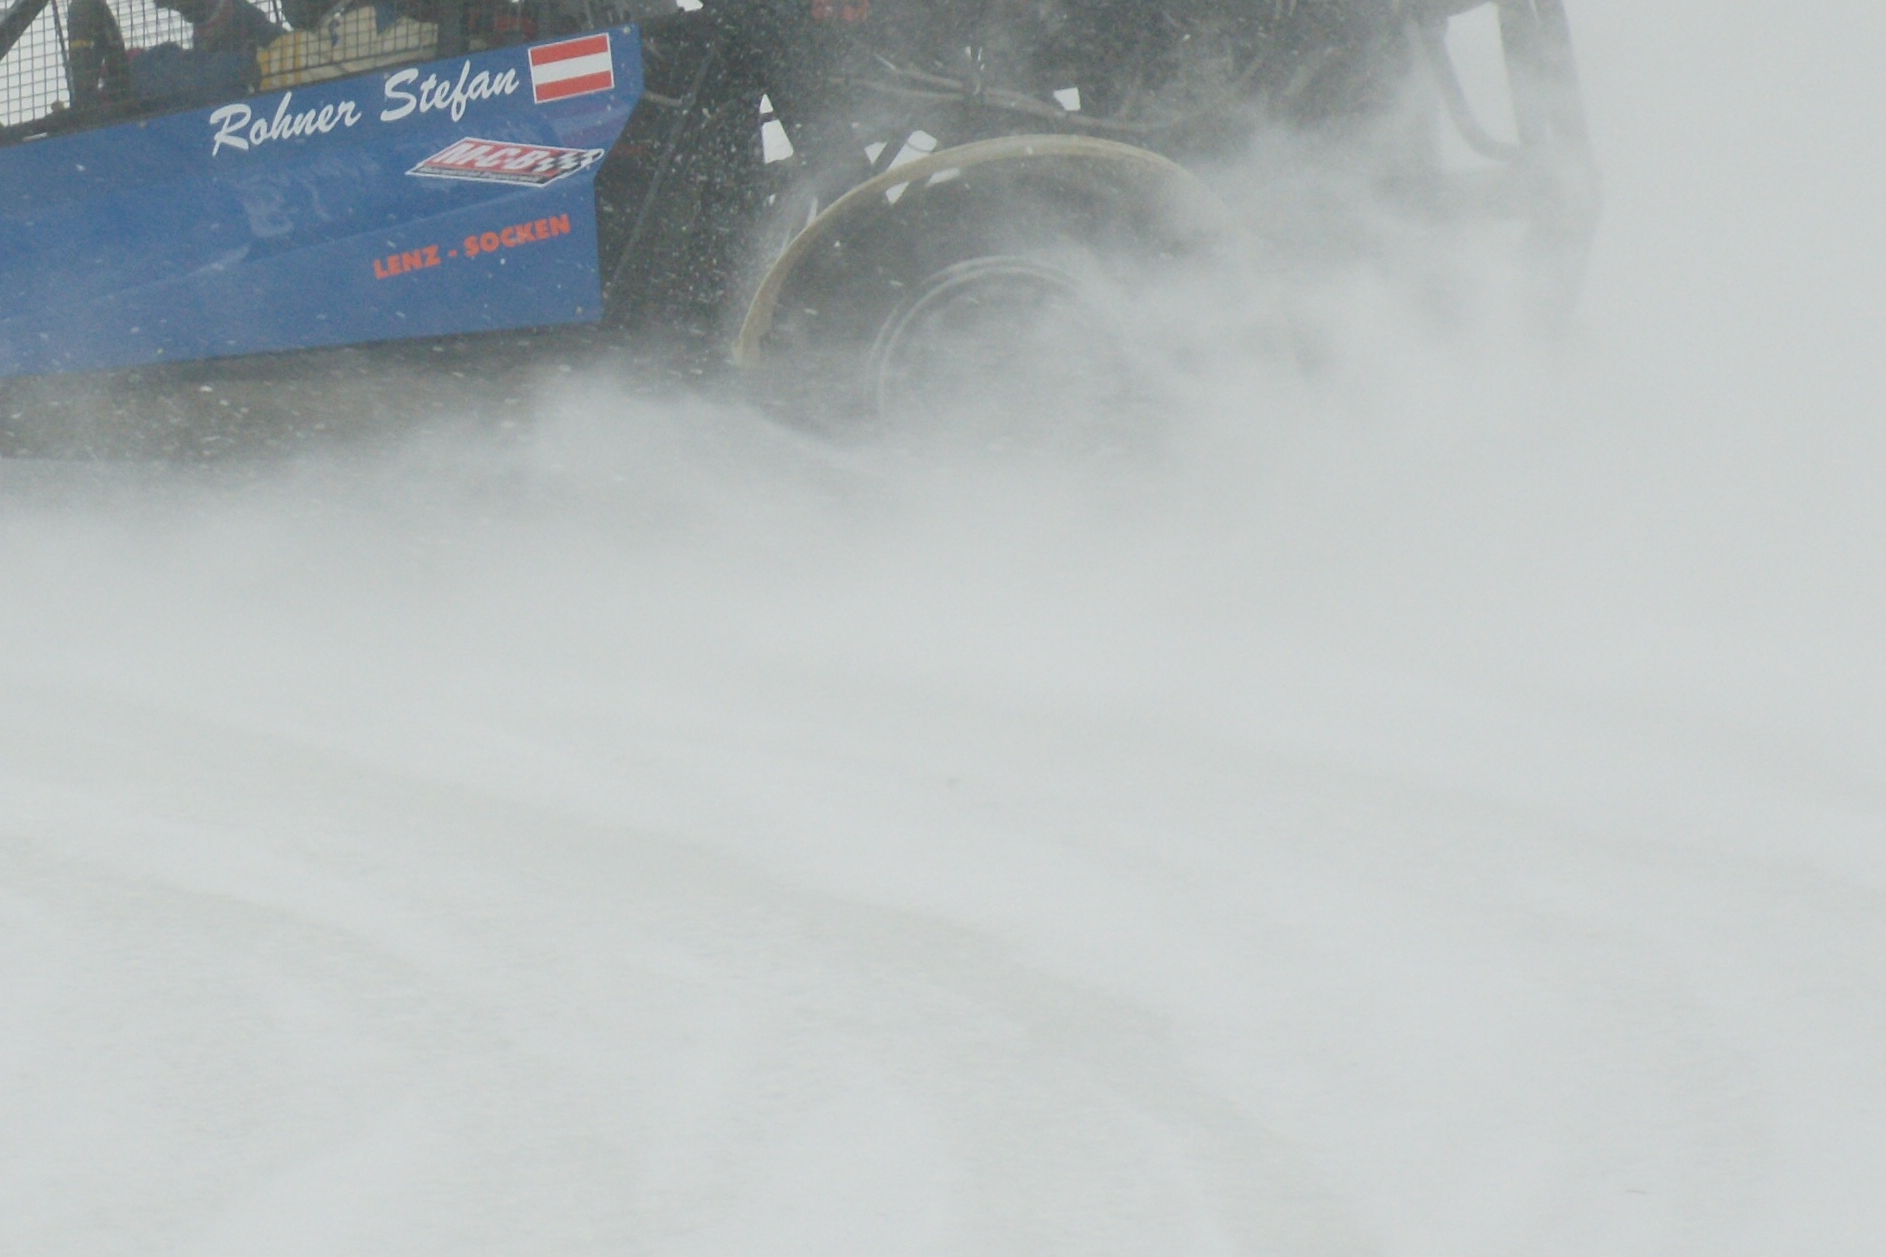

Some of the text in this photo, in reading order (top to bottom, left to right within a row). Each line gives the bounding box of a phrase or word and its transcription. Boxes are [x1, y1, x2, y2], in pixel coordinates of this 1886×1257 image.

[210, 59, 520, 157] Rohner Stefan
[373, 244, 441, 280] LENZ
[464, 213, 571, 257] SOCKEN
